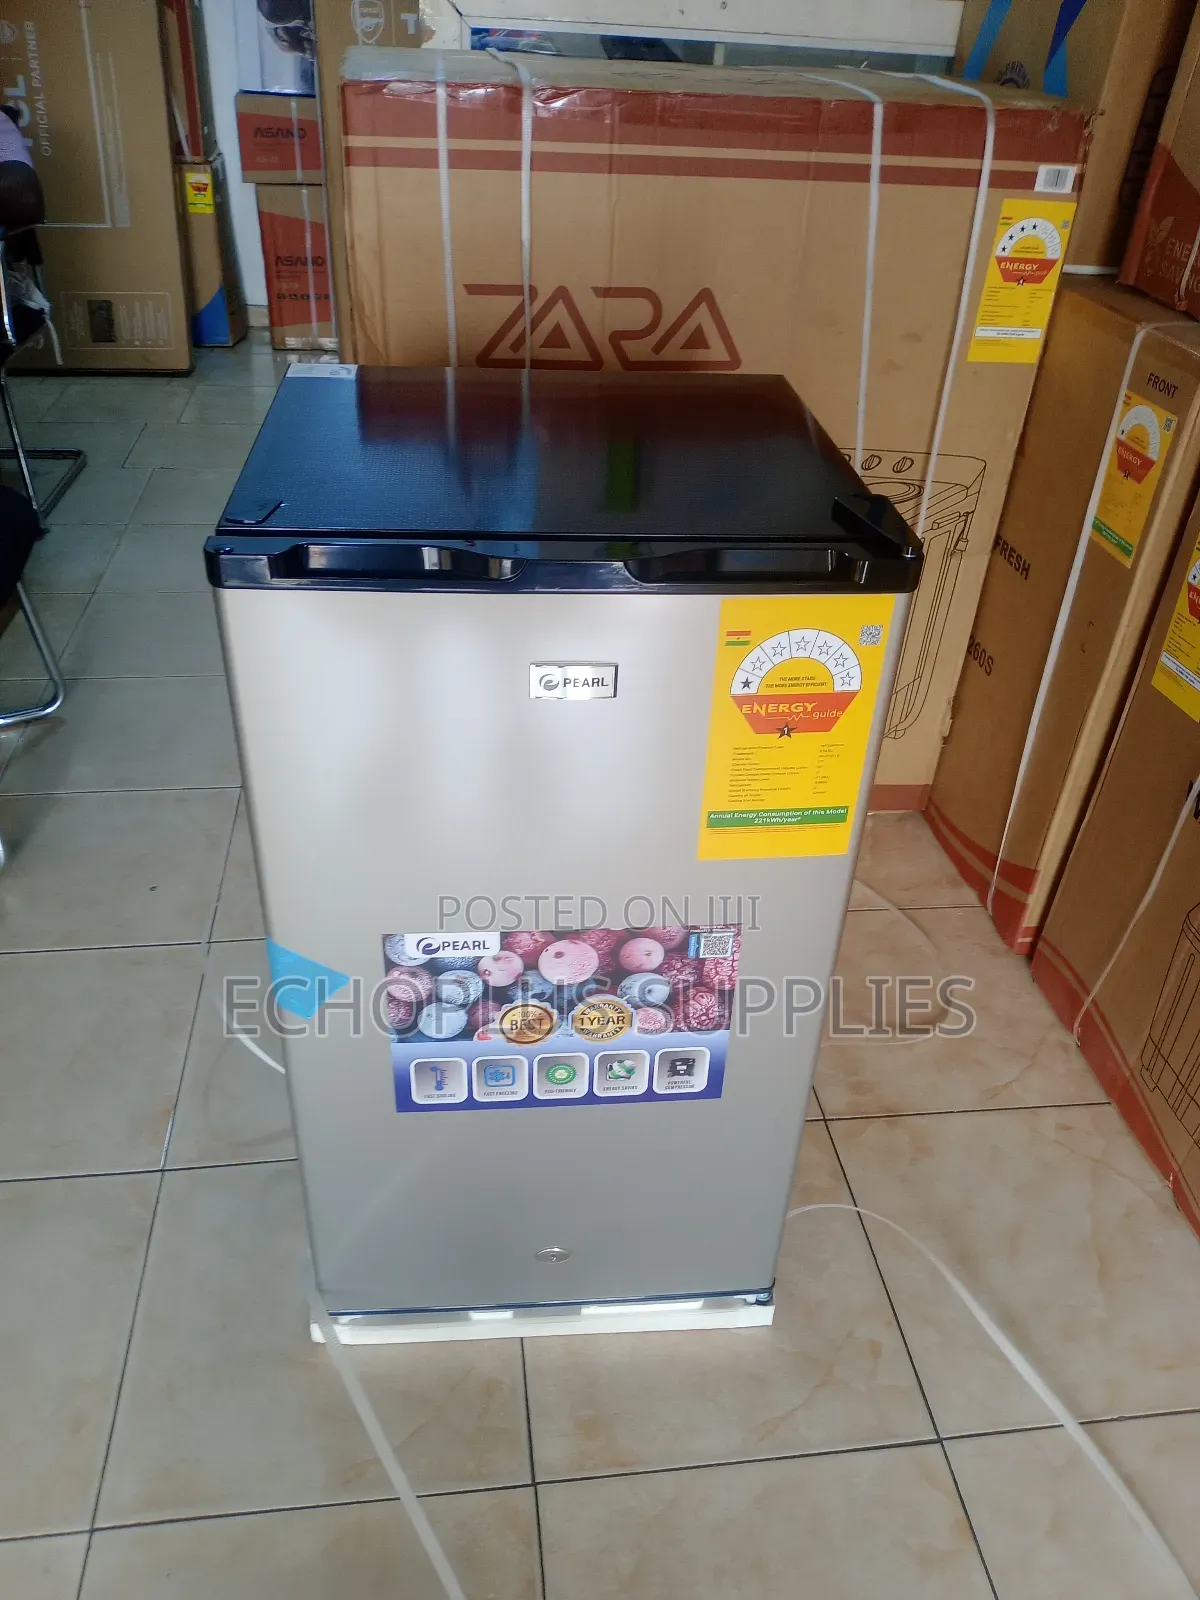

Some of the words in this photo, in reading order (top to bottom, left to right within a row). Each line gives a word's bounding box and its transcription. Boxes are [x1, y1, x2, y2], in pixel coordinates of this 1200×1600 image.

[33, 91, 52, 157] OFFICIAL
[1000, 260, 1040, 272] ENERGY
[462, 283, 742, 372] ZARA
[1146, 372, 1179, 399] FRONT
[992, 534, 1031, 581] FRESH
[563, 677, 609, 688] PEARL
[742, 701, 818, 717] ENERGY
[812, 709, 843, 720] guide
[442, 939, 490, 951] PEARL
[584, 1003, 622, 1015] WARRANTY
[510, 1018, 544, 1031] BEST
